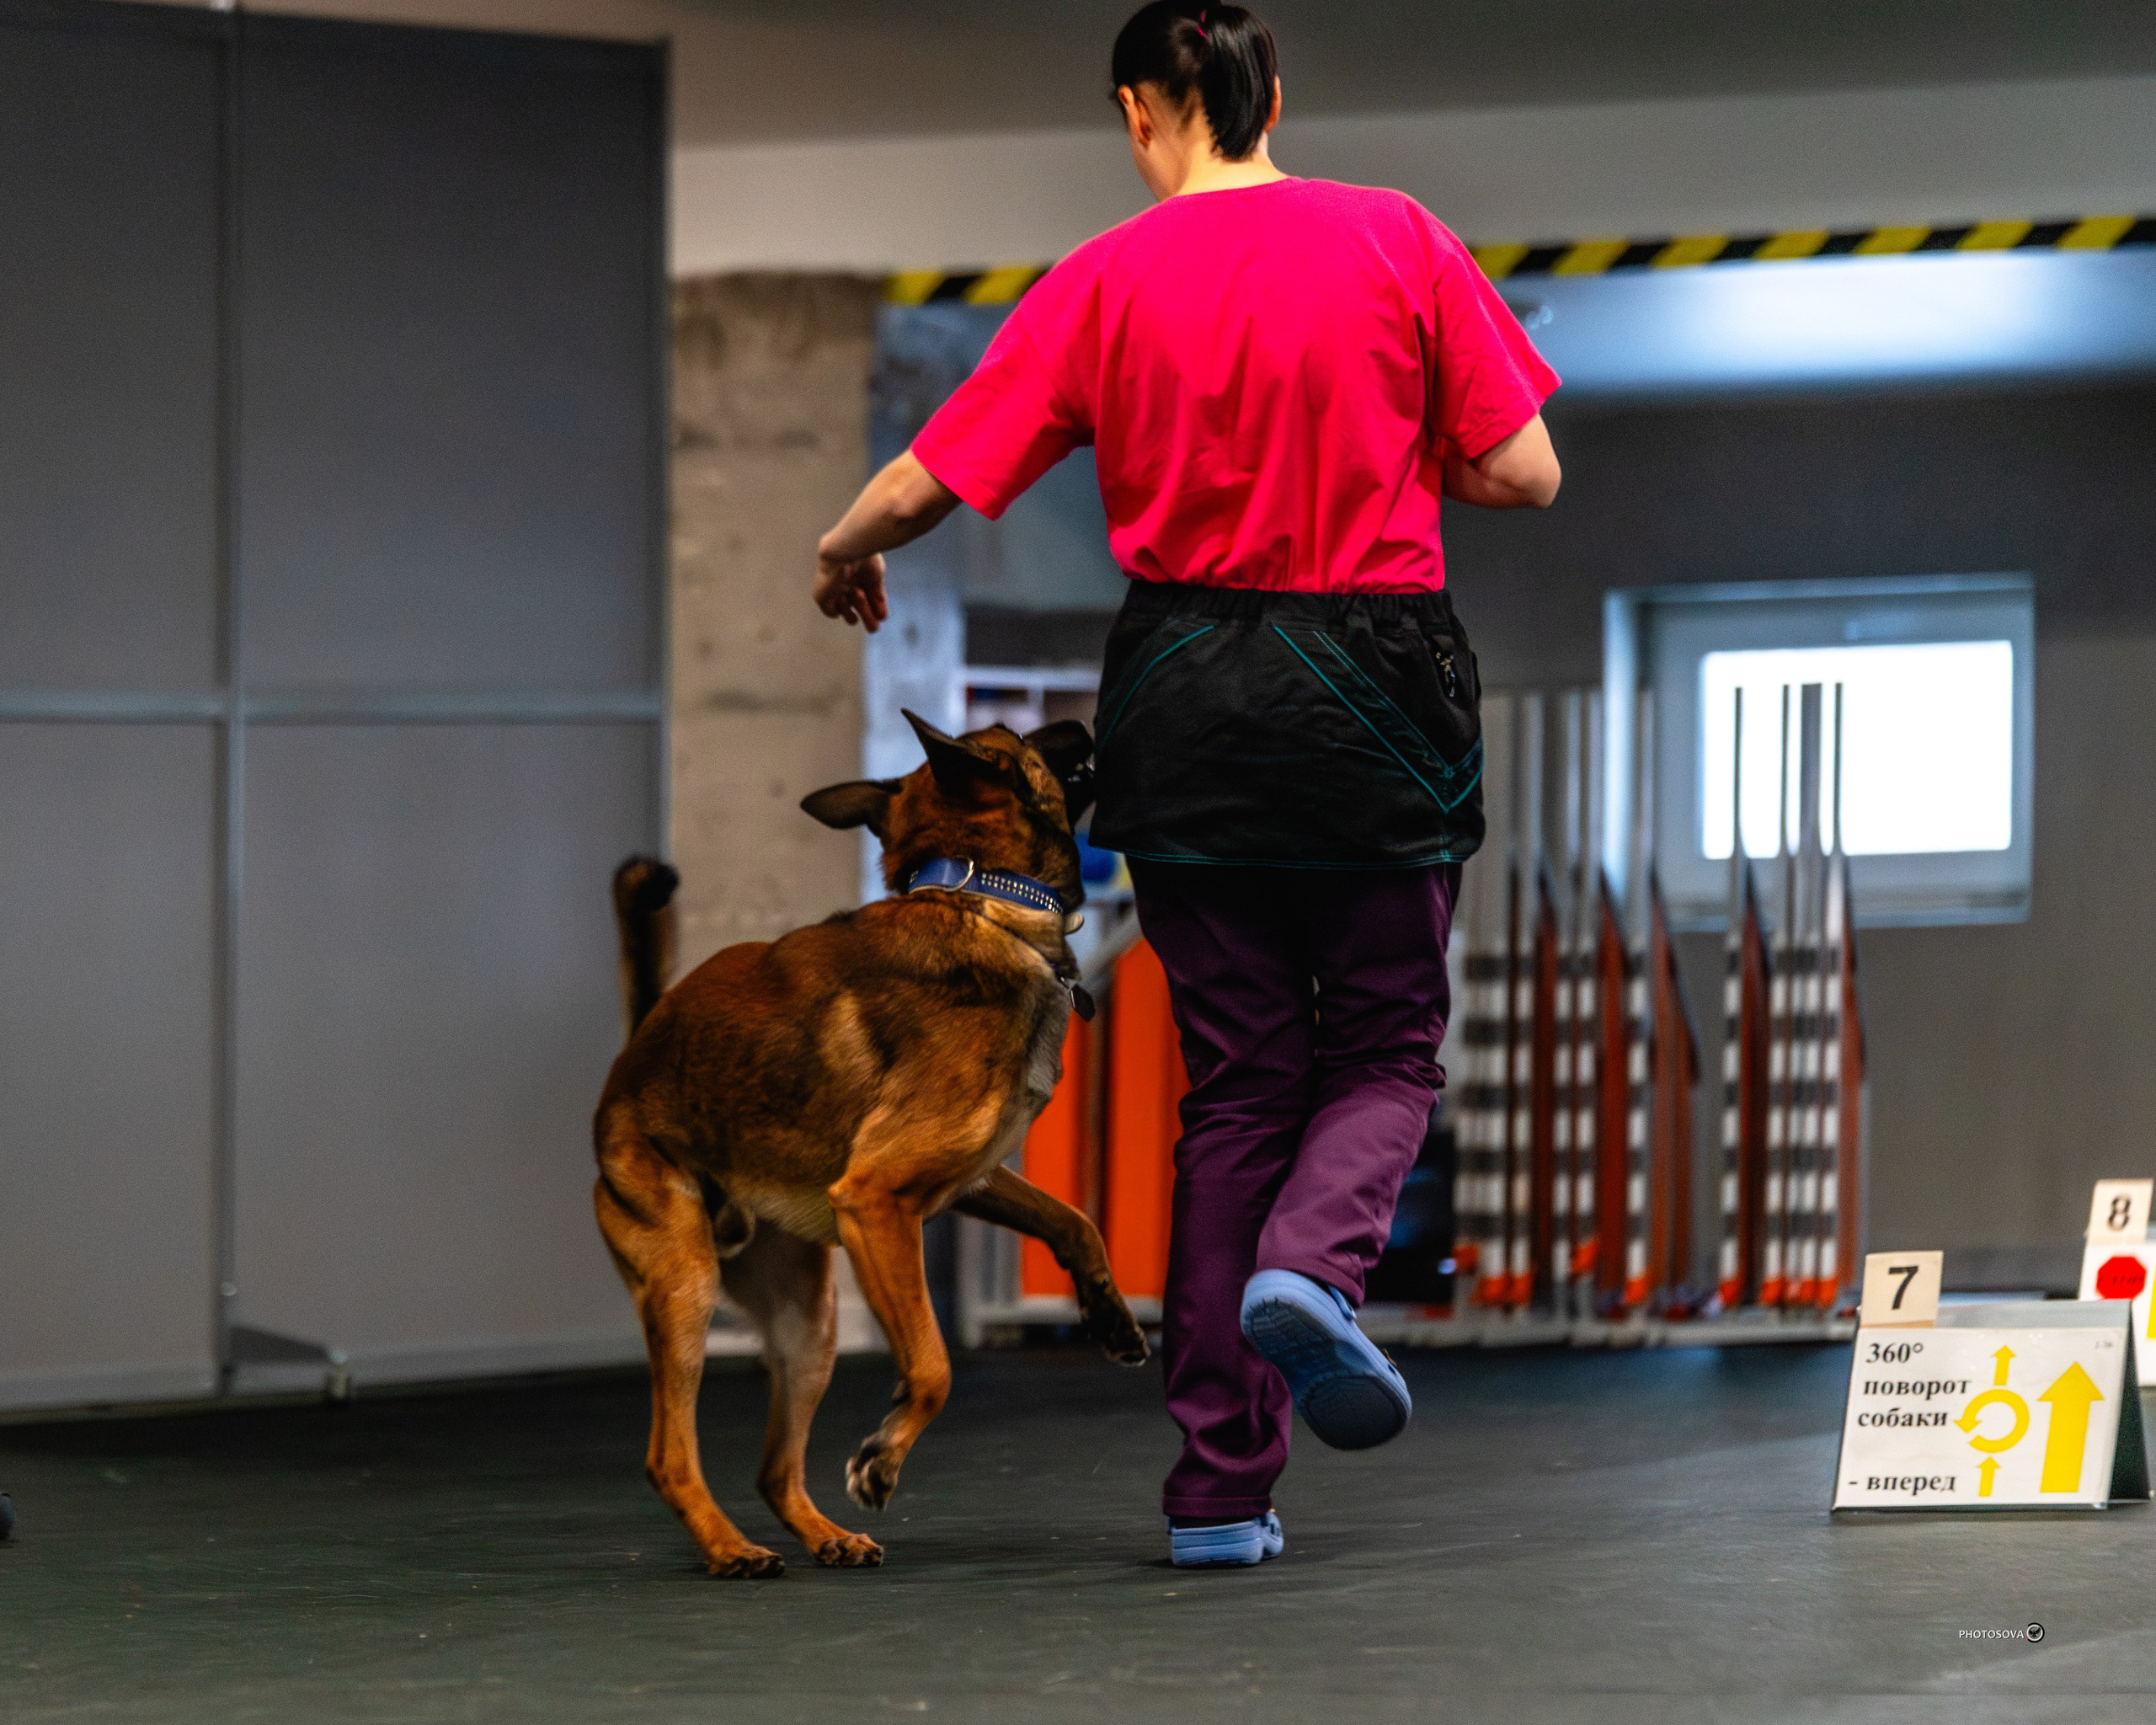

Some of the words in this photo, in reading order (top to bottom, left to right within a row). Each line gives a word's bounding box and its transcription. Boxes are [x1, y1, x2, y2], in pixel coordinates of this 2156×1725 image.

[2107, 1193, 2132, 1231] 8
[1887, 1265, 1919, 1310] 7
[1865, 1342, 1924, 1364] 360°
[1863, 1379, 1972, 1401] поворот
[1858, 1407, 1948, 1428] собаки
[1866, 1475, 1956, 1496] вперед
